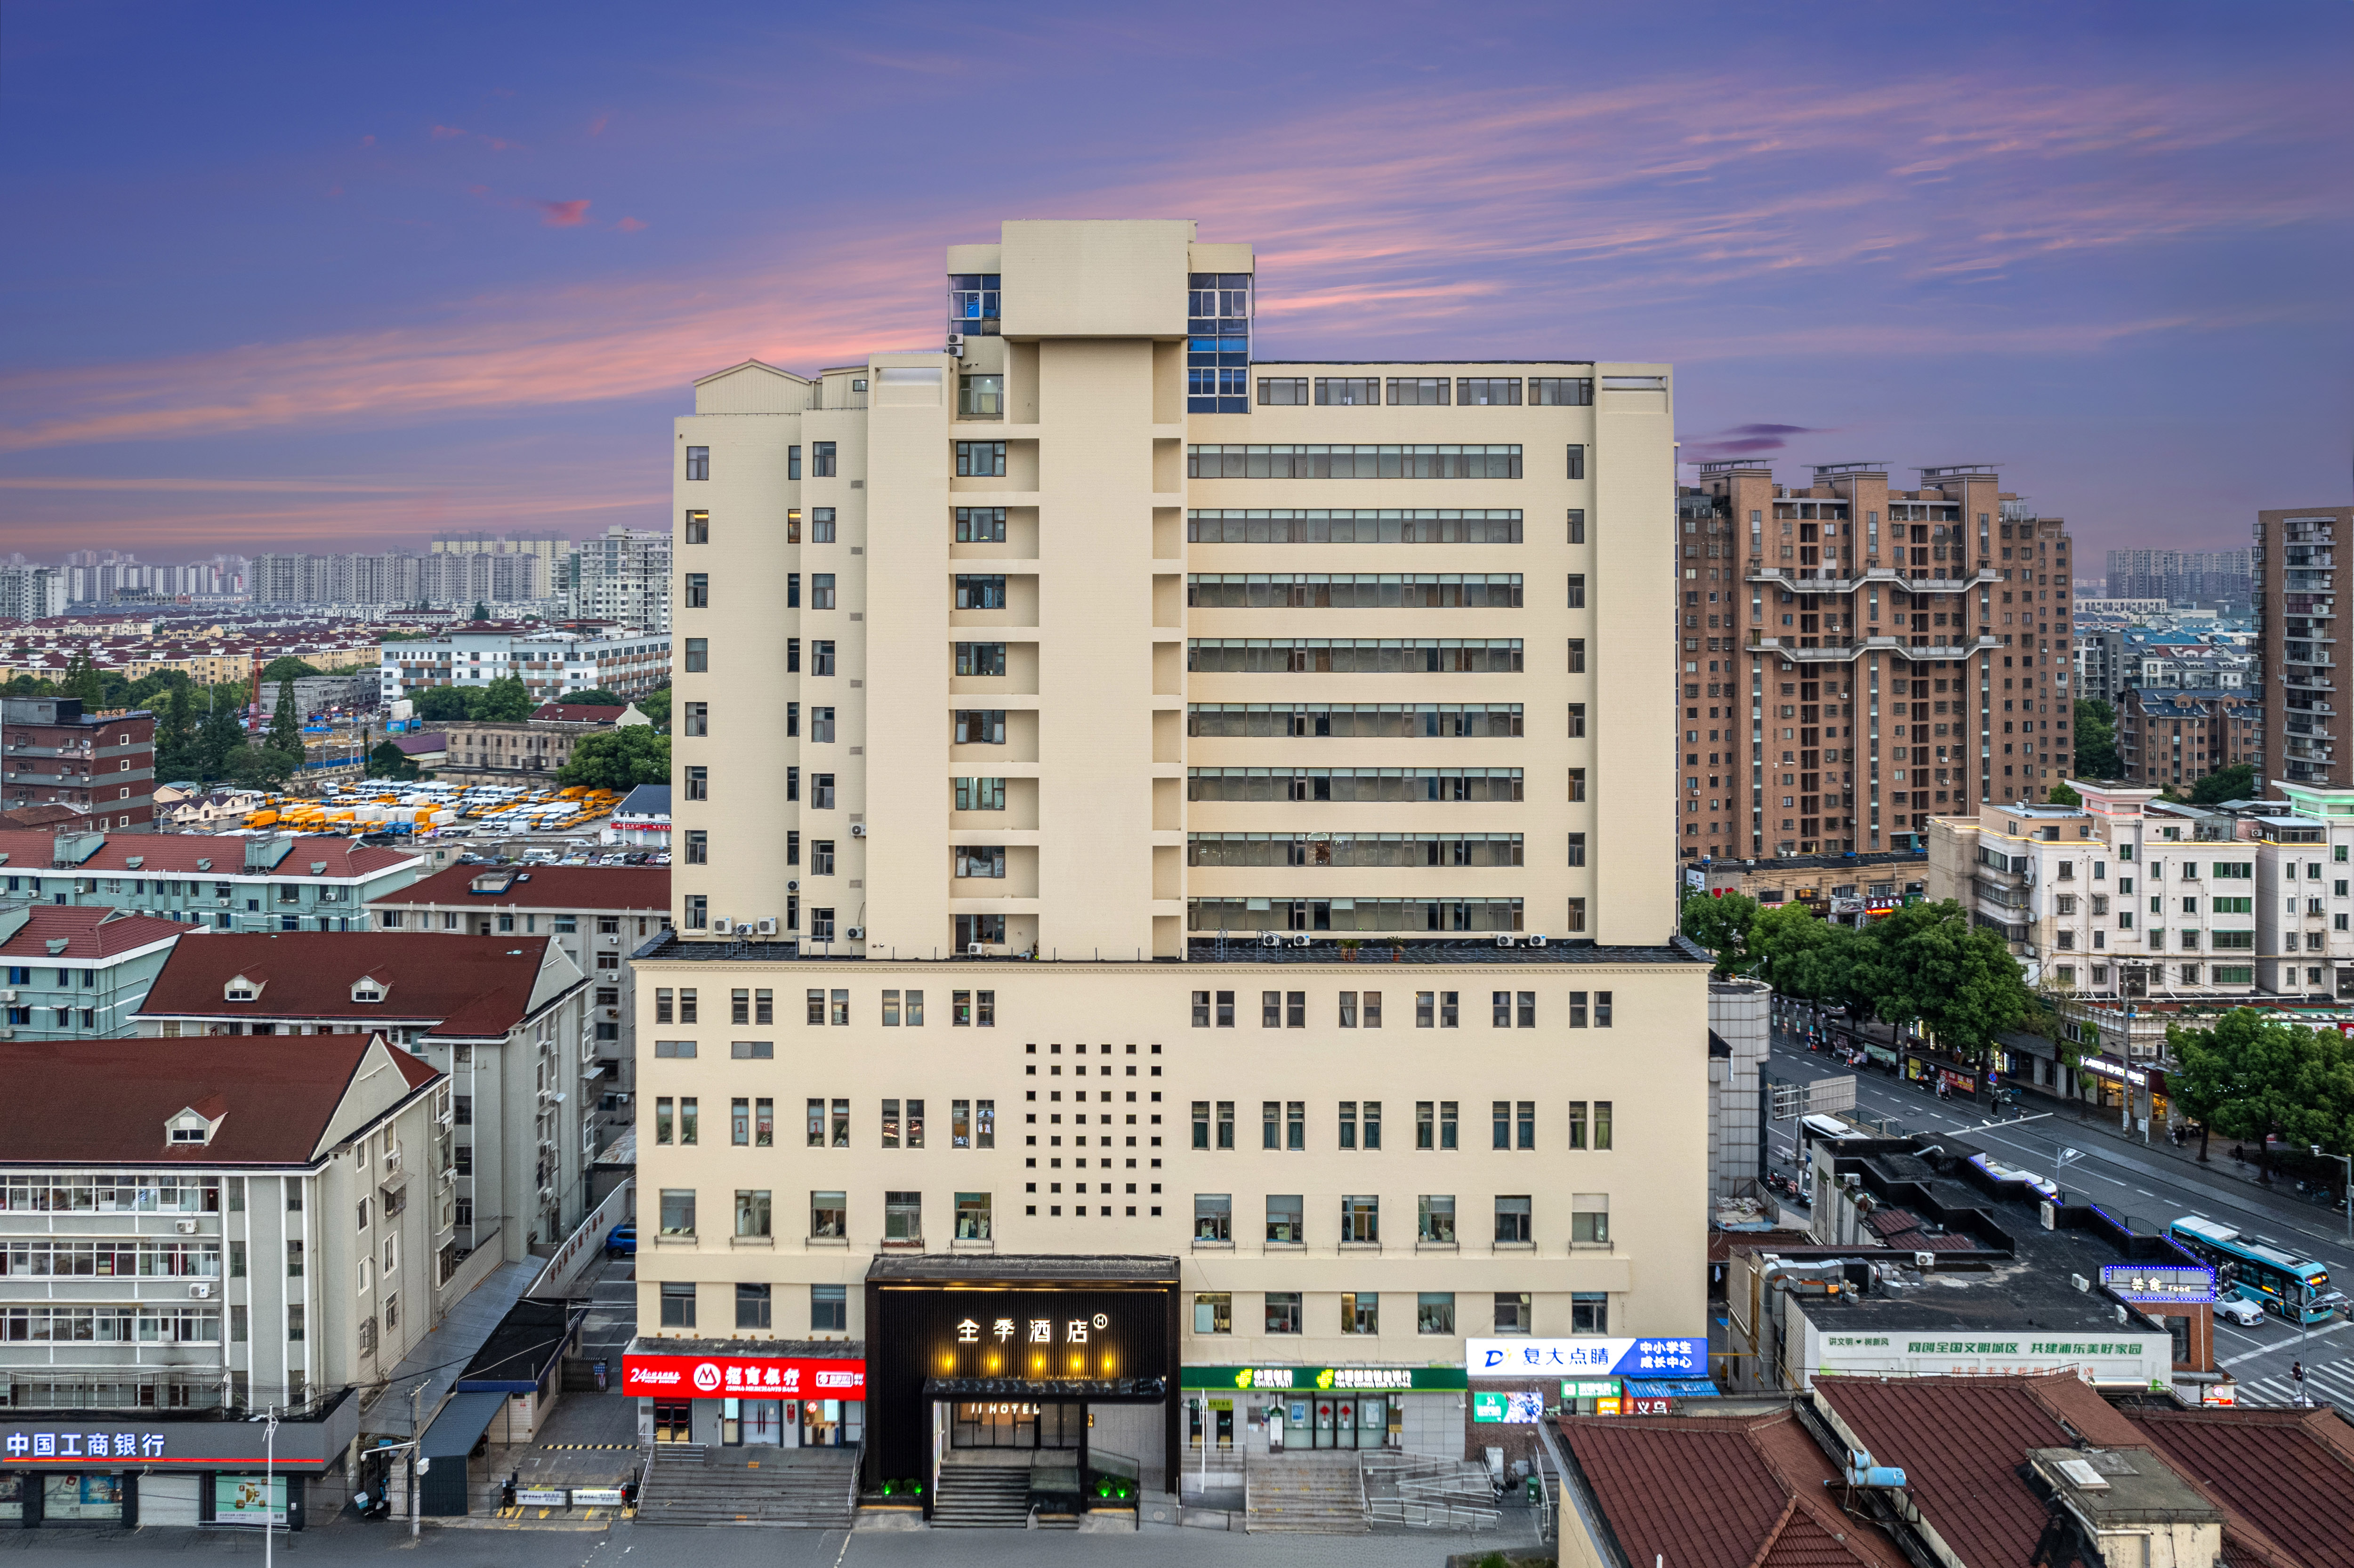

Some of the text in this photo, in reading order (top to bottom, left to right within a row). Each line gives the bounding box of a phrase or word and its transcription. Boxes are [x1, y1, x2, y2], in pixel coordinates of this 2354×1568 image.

[96, 708, 126, 720] 青年公寓
[2131, 1277, 2162, 1292] 美食
[957, 1318, 1088, 1343] 全季酒店
[1640, 1341, 1693, 1354] 中小学生
[1829, 1337, 1889, 1346] 讲文明 树新风
[1908, 1342, 2142, 1355] 同创全国文明城区 共建浦东美好家园
[1523, 1347, 1609, 1366] 复大点睛
[1640, 1356, 1693, 1368] 成长中心
[989, 1402, 1040, 1415] HOTEL
[7, 1432, 164, 1457] 中国工商银行
